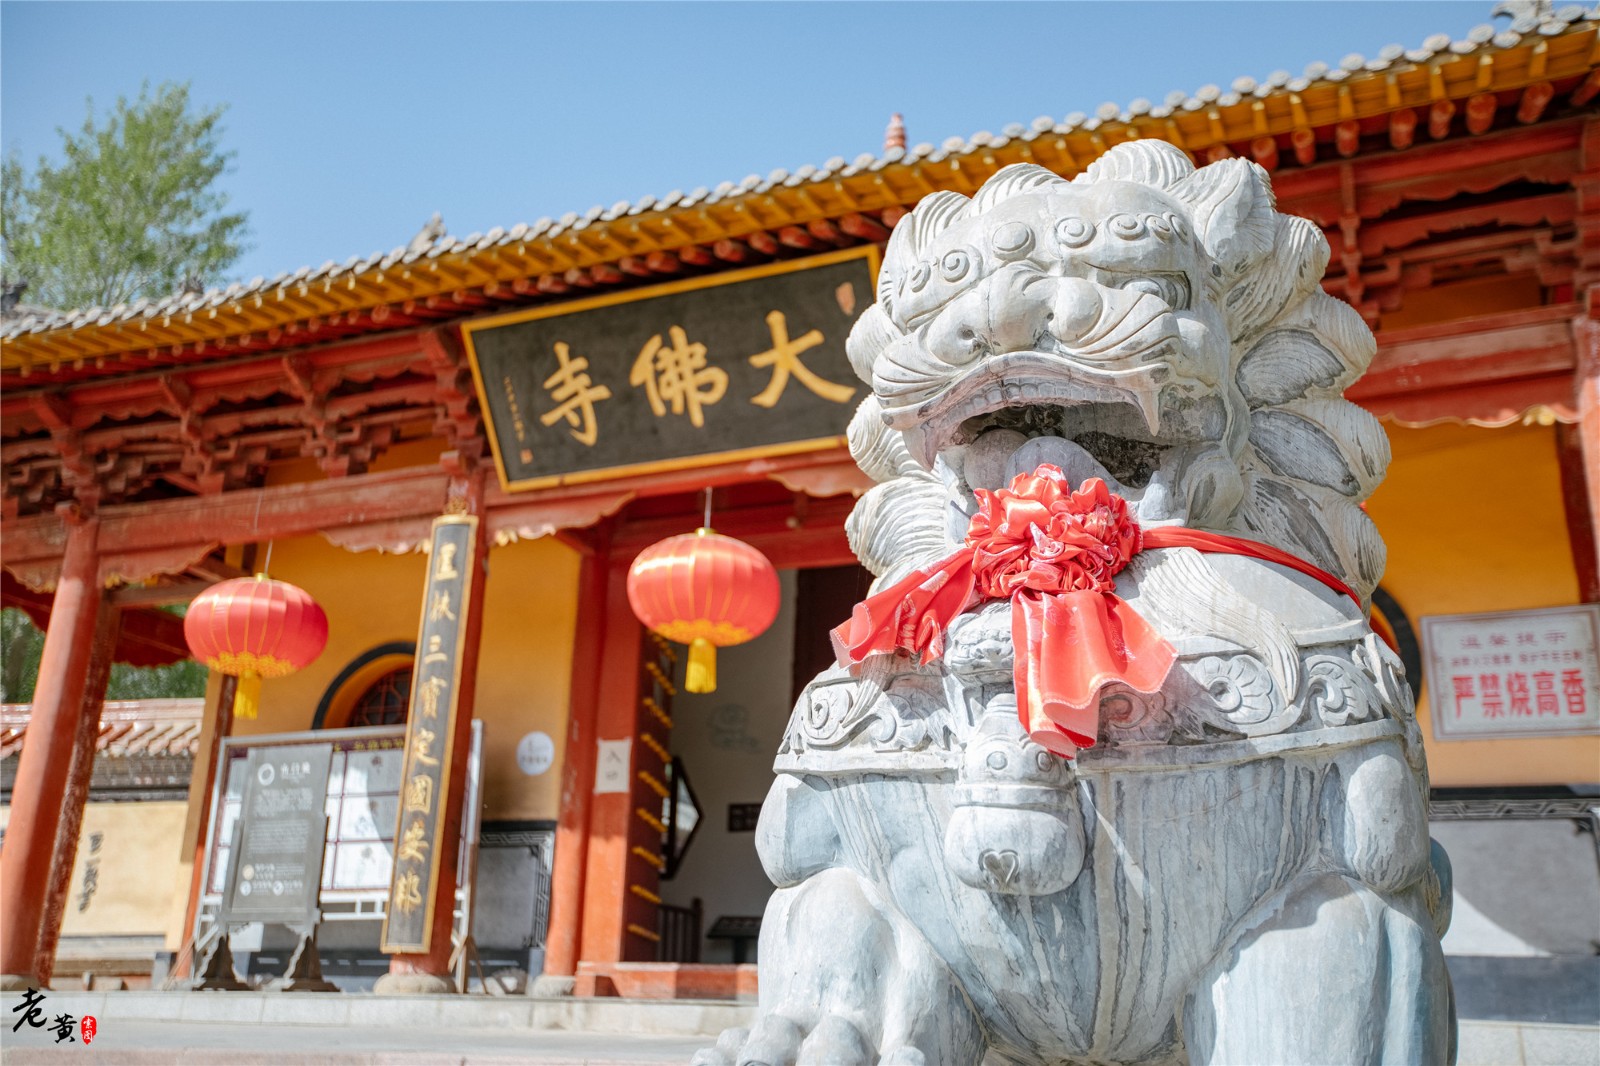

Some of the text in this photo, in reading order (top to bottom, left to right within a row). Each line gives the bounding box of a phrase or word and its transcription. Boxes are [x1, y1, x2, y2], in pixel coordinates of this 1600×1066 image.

[539, 309, 857, 447] 大佛寺
[1452, 668, 1587, 720] 严禁烧高香
